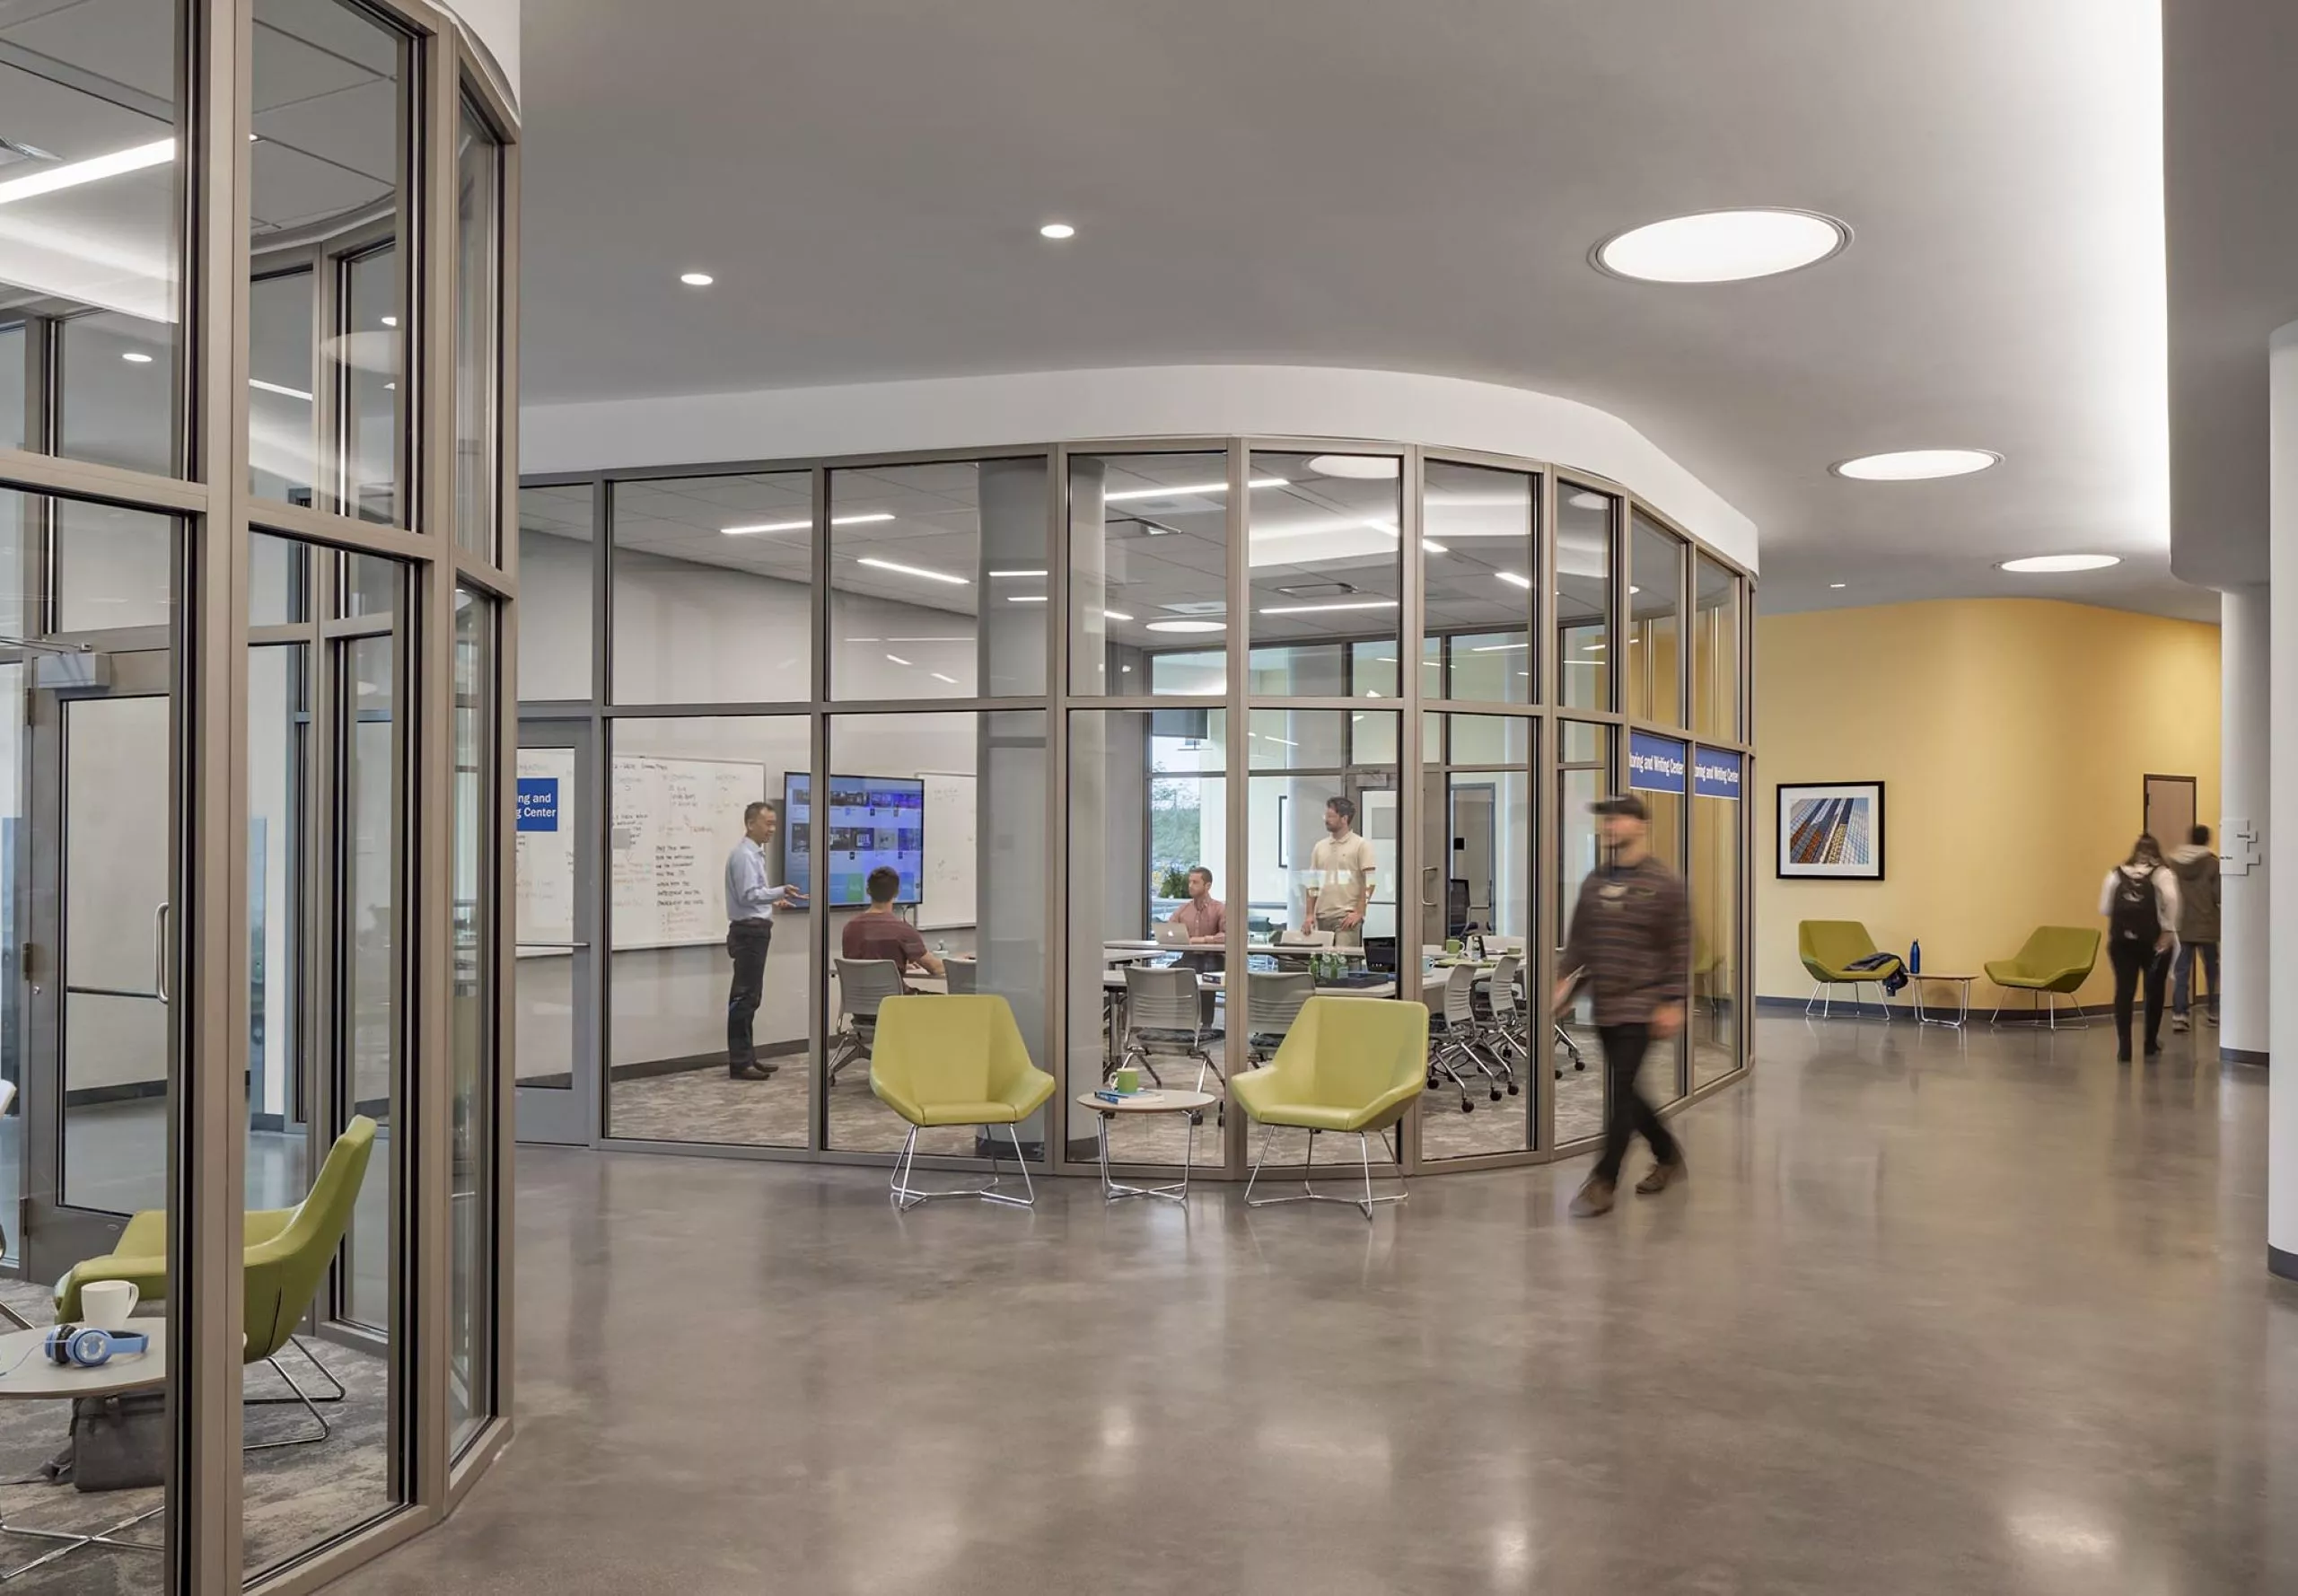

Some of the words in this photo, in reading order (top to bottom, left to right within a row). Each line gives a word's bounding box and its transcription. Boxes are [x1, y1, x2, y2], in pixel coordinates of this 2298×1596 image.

[1644, 755, 1653, 771] and
[1653, 755, 1670, 777] Writing
[1670, 759, 1684, 776] Center
[1706, 766, 1714, 779] and
[1714, 766, 1728, 785] Writing
[1727, 768, 1739, 783] Center
[532, 793, 552, 803] and
[523, 807, 557, 818] Center
